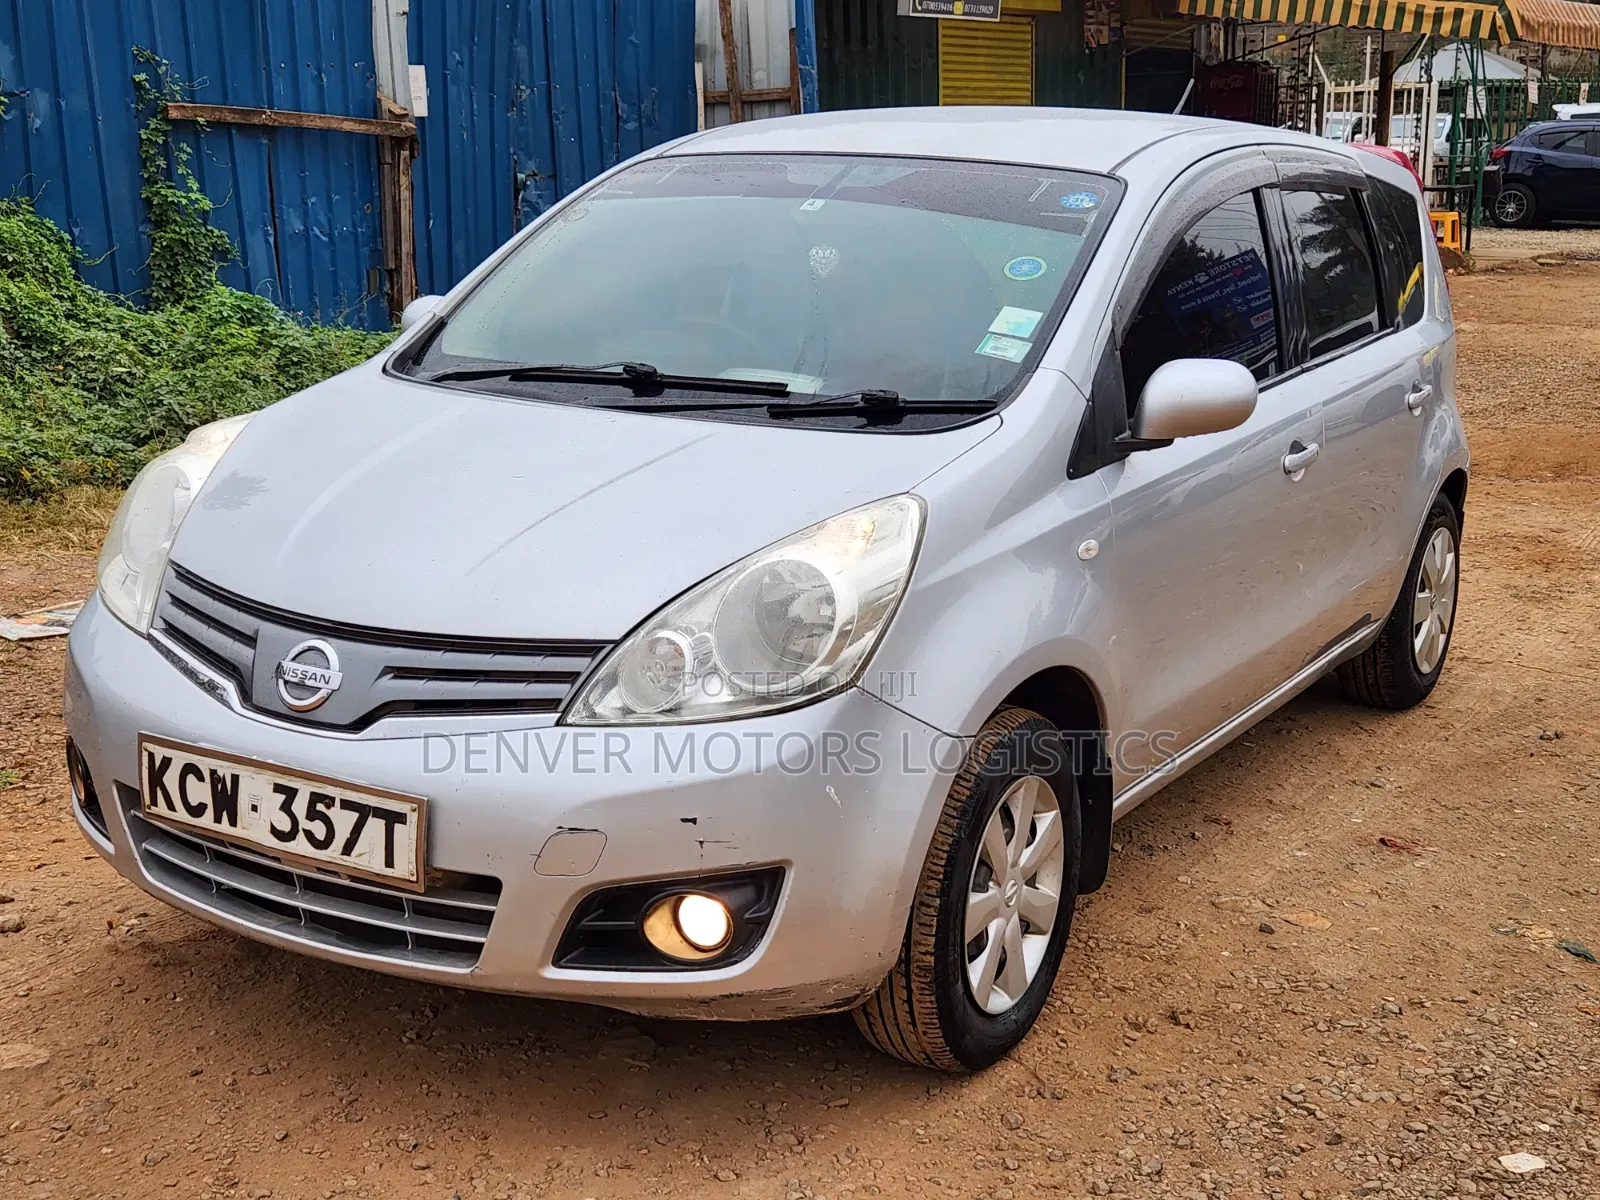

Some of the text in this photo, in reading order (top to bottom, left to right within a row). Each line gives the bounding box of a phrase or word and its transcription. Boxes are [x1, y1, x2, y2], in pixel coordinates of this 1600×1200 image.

[280, 664, 332, 686] NISSAN
[147, 749, 408, 869] KCW 357T
